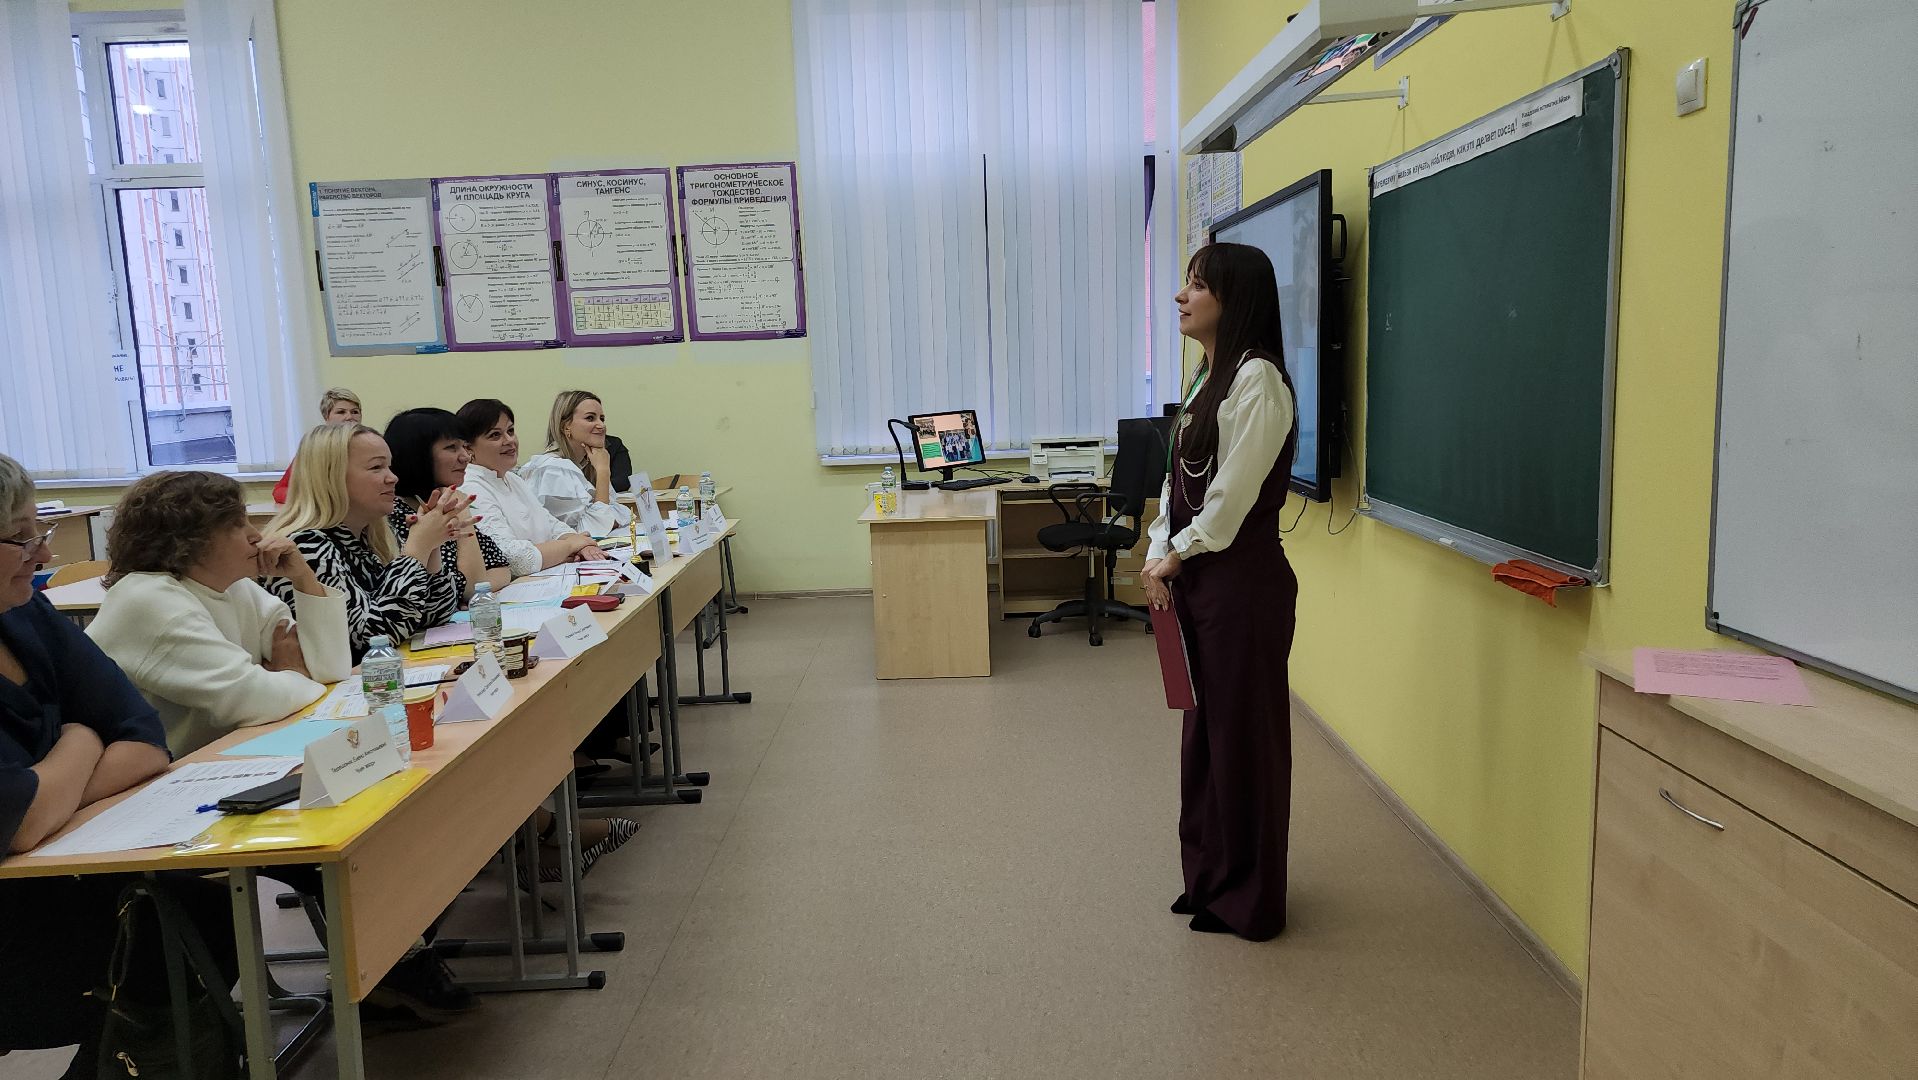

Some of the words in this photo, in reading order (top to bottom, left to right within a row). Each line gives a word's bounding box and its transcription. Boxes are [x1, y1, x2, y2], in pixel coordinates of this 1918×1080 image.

[1475, 130, 1497, 150] делает
[713, 171, 759, 181] ОСНОВНОЕ
[576, 179, 606, 188] СИНУС,
[606, 178, 647, 187] КОСИНУС,
[690, 179, 785, 189] ТРИГОНОМЕТРИЧЕСКОЕ
[450, 186, 478, 195] ДЛИНА
[478, 184, 534, 193] ОКРУЖНОСТИ
[595, 187, 631, 196] ТАНГЕНС
[463, 193, 505, 202] ПЛОЩАДЬ
[506, 191, 531, 199] КРУГА
[691, 197, 732, 206] ФОРМУЛЫ
[733, 195, 787, 204] ПРИВЕДЕНИЯ
